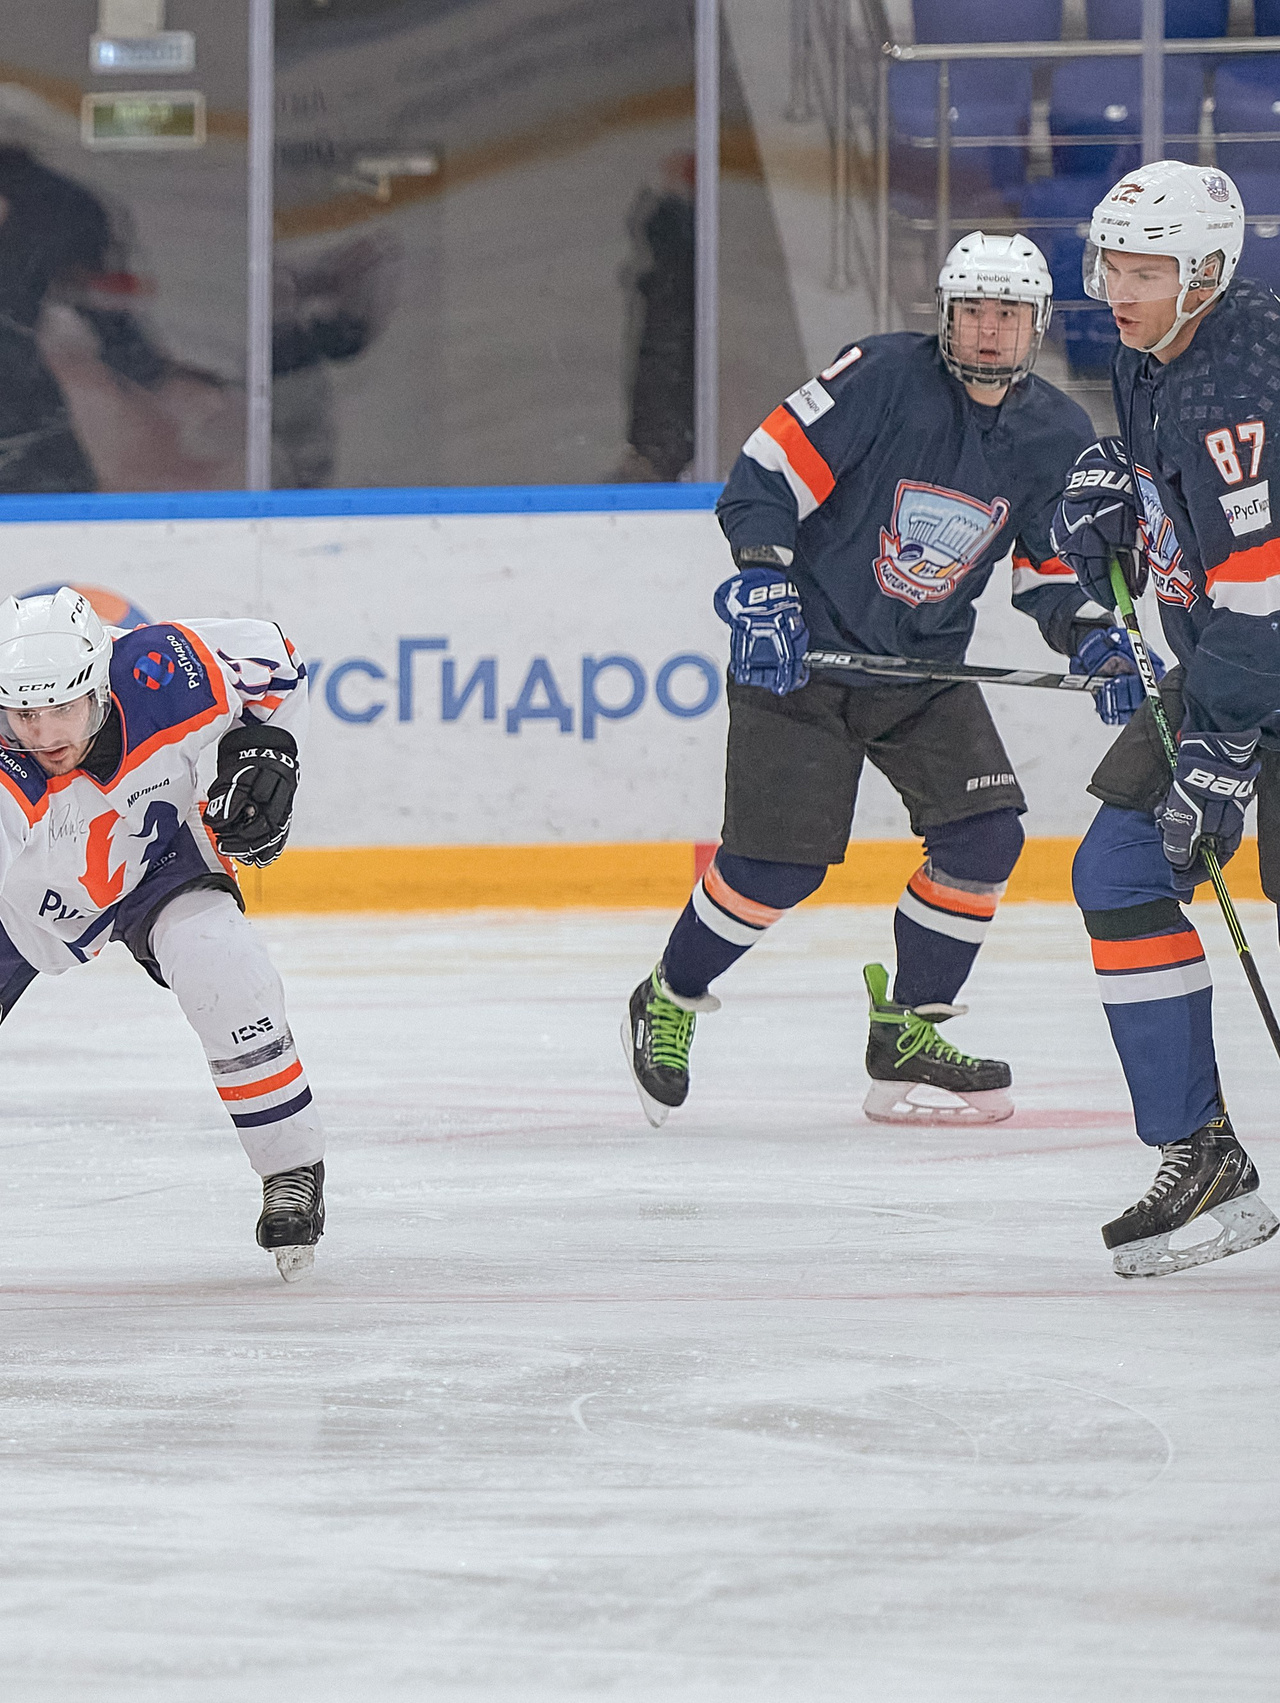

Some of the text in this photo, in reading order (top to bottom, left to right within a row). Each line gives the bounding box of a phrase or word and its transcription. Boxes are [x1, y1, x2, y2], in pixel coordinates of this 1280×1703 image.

[1205, 421, 1265, 485] 87
[748, 581, 800, 605] BAU
[166, 634, 200, 689] РусГидро
[1133, 641, 1156, 689] CCM
[18, 682, 56, 692] CCM
[308, 637, 720, 740] сГидро
[238, 747, 295, 769] MAD
[1183, 767, 1257, 799] BAU
[38, 888, 86, 922] Ру
